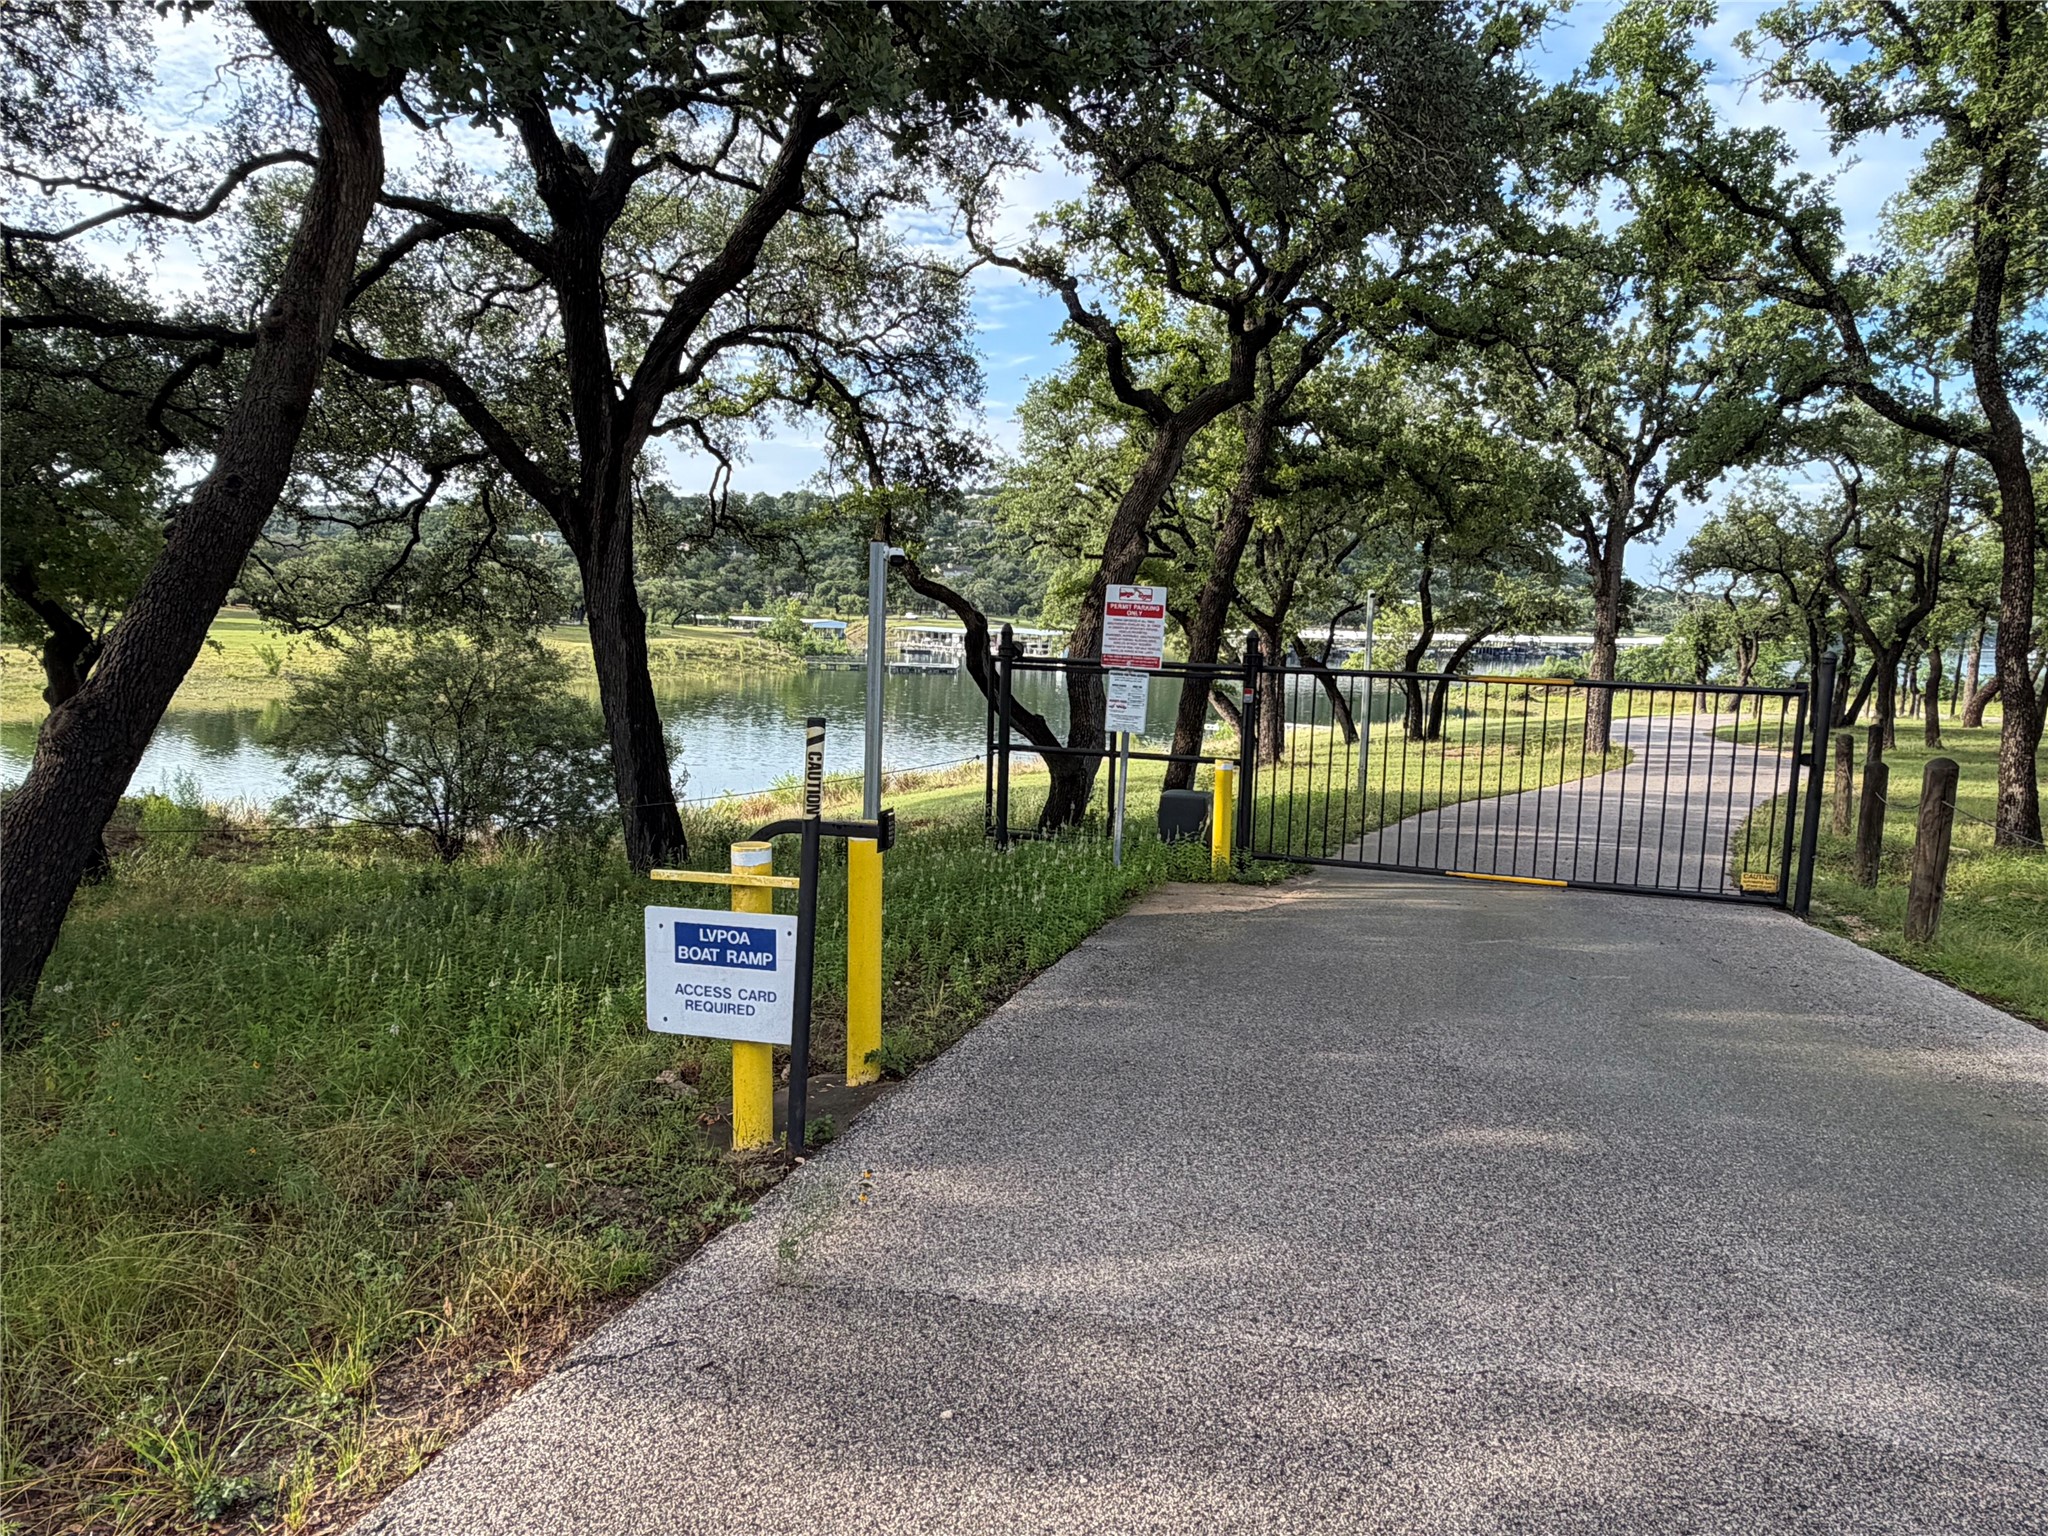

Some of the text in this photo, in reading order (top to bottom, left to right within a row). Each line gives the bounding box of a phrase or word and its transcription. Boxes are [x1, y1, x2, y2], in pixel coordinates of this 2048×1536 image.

[1133, 604, 1160, 612] PARKING
[806, 751, 822, 815] CAUTION
[1743, 873, 1779, 881] CAUTION
[699, 928, 751, 946] LVPOA
[678, 945, 773, 966] BOAT RAMP
[675, 983, 777, 1003] ACCESS CARD
[685, 999, 756, 1016] REQUIRED
